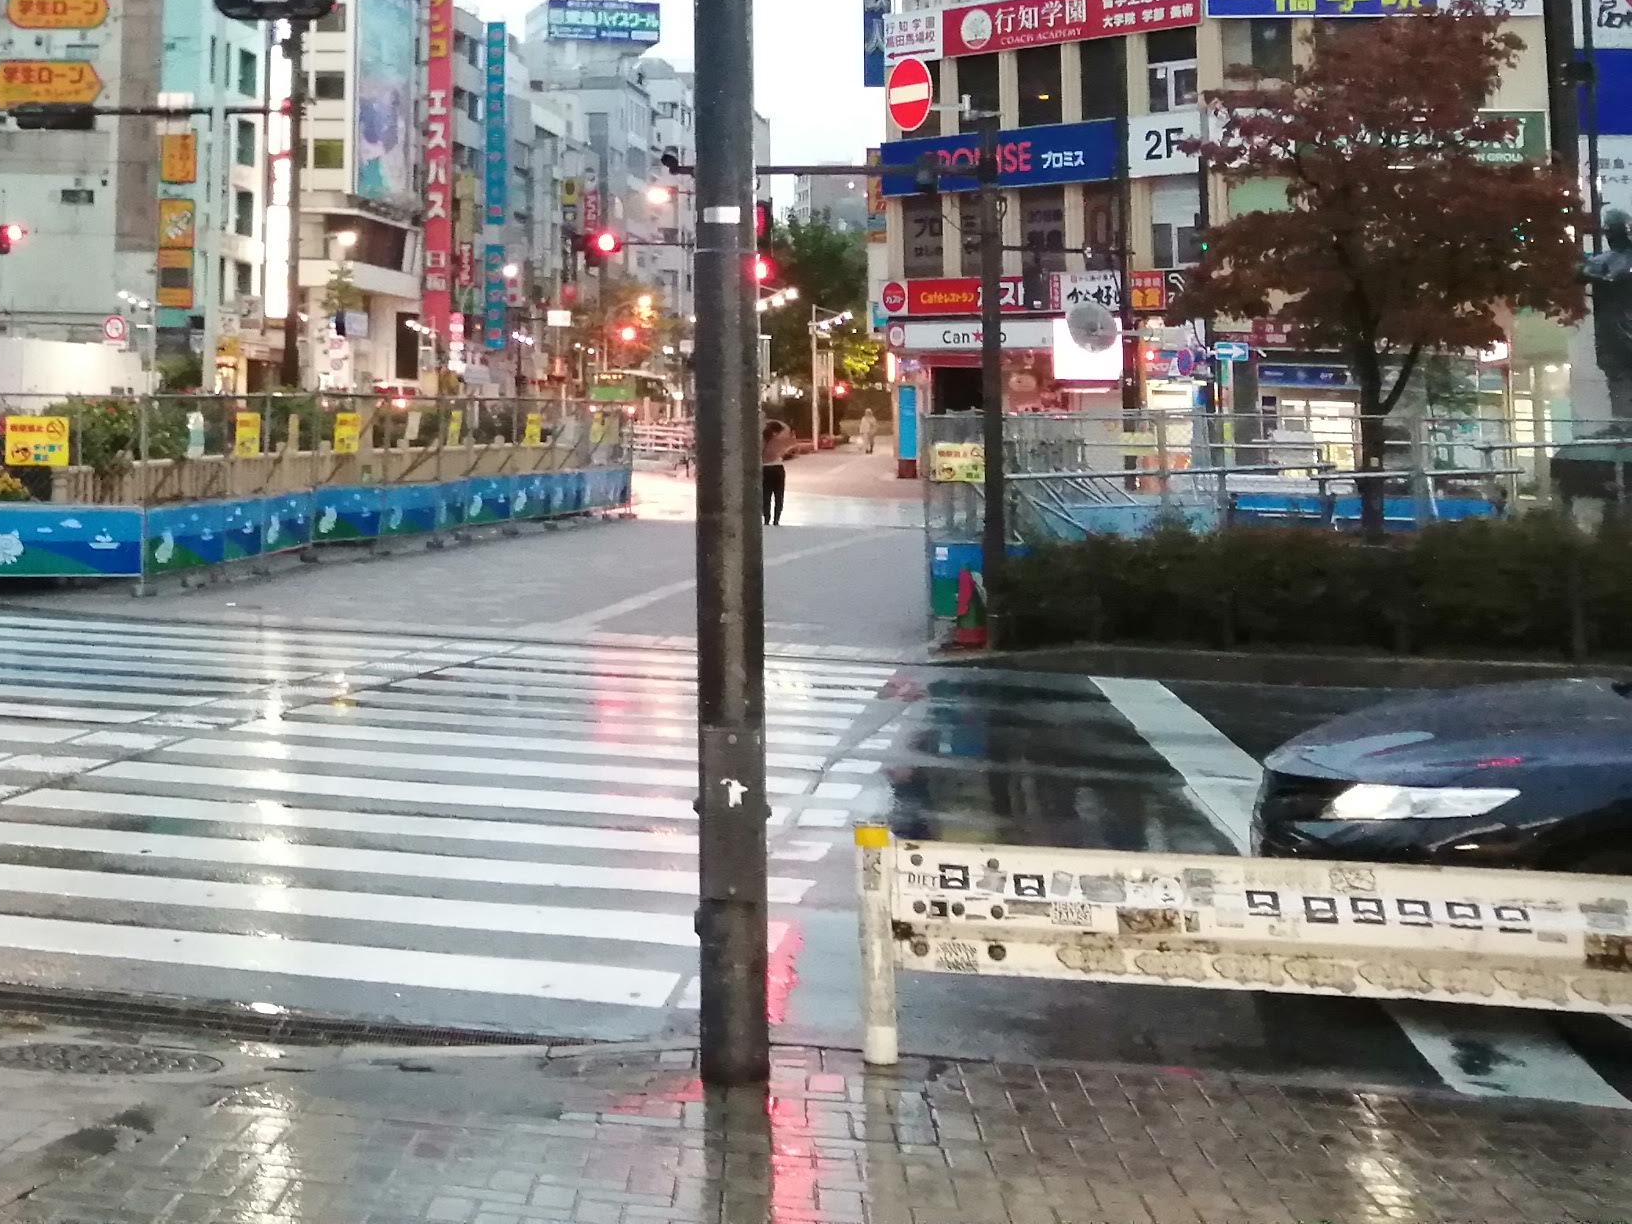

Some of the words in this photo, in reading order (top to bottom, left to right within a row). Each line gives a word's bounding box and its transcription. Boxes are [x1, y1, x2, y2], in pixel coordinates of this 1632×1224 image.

[427, 89, 447, 219] エスパス
[1144, 126, 1185, 161] 2F
[1040, 150, 1086, 169] プロミス
[942, 329, 970, 344] Can
